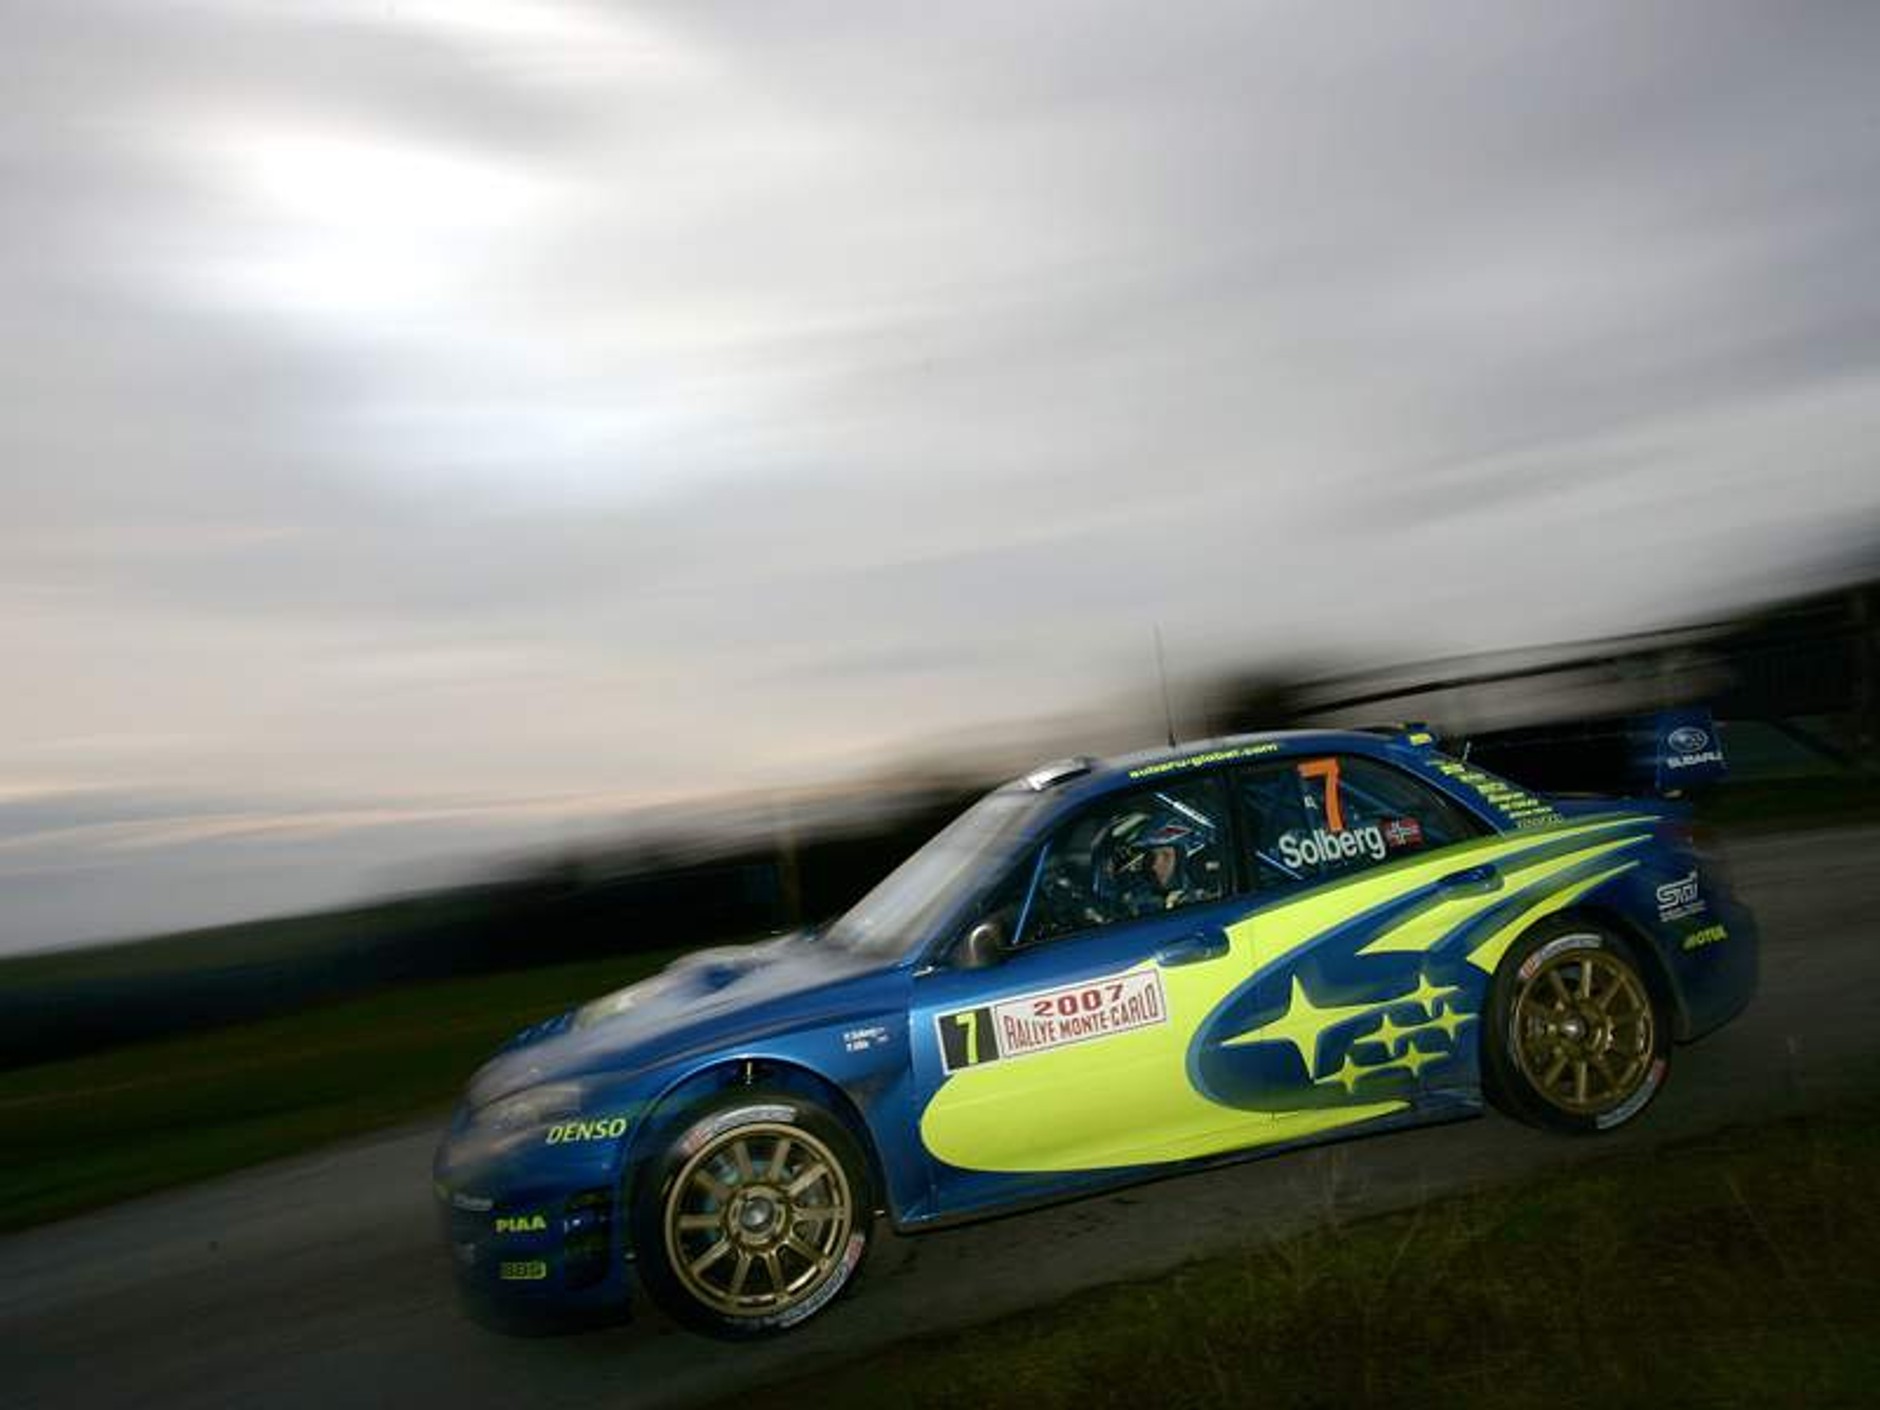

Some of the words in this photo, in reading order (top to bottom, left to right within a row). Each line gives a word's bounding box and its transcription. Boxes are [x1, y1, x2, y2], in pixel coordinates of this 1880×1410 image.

[1297, 757, 1343, 832] 7
[1279, 826, 1386, 868] Solberg
[1034, 984, 1123, 1017] 2007
[956, 1012, 979, 1065] 7
[1003, 1015, 1056, 1050] RALLYE
[545, 1118, 627, 1145] DENSO
[495, 1215, 547, 1232] PIAA
